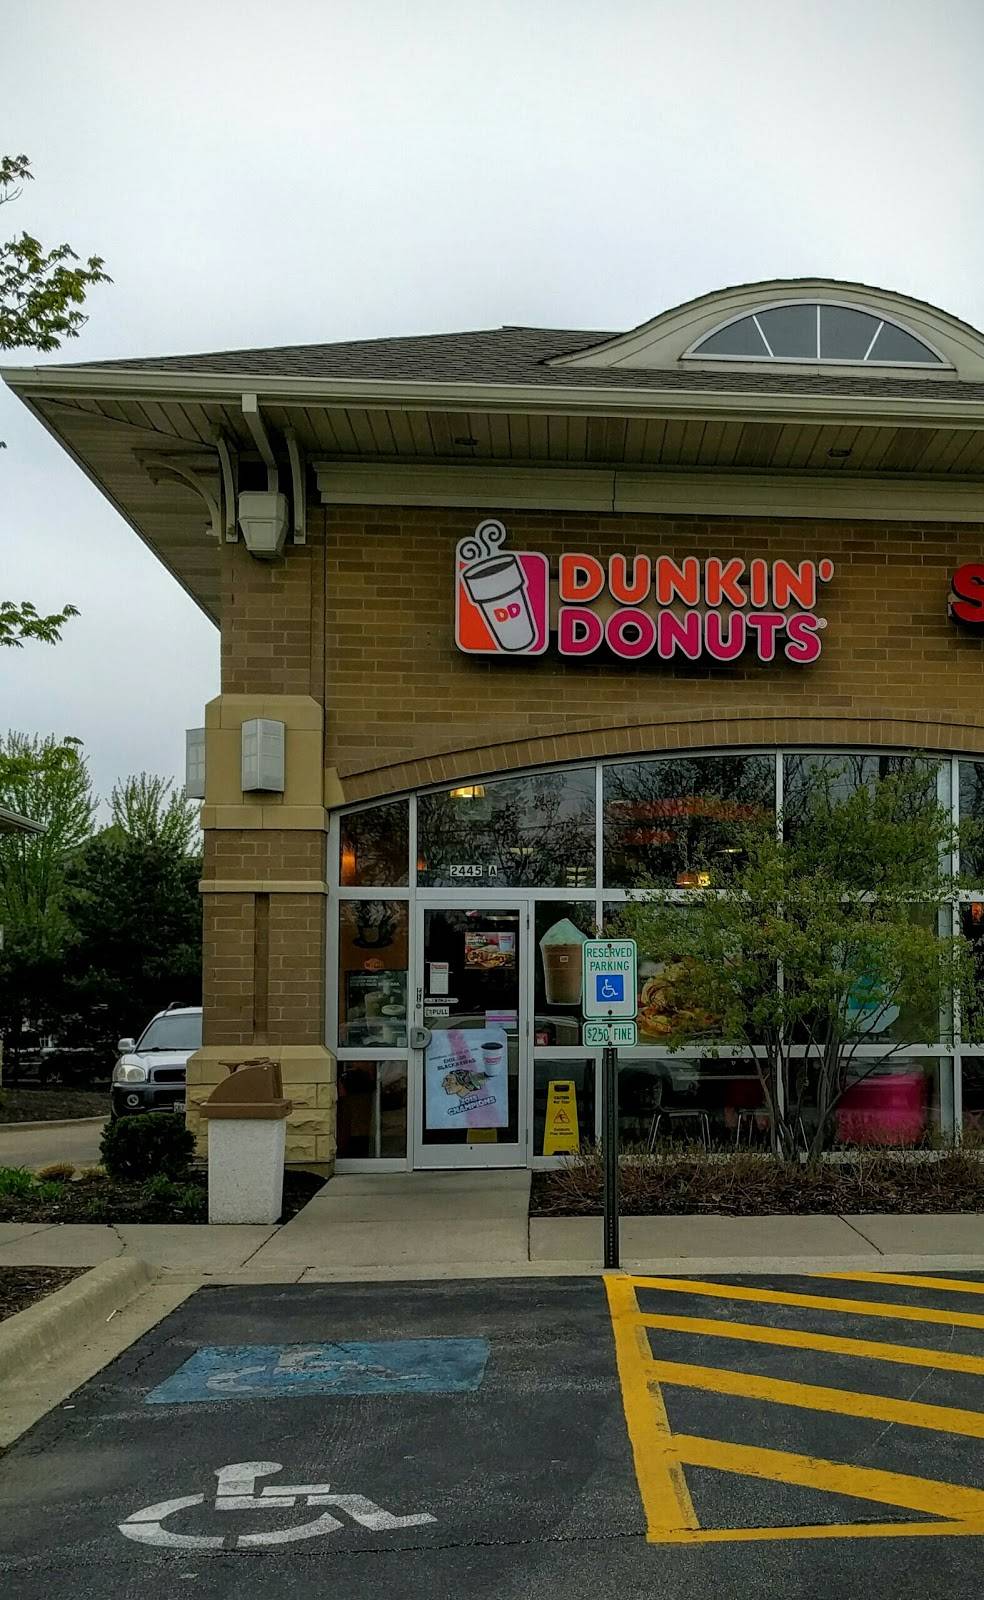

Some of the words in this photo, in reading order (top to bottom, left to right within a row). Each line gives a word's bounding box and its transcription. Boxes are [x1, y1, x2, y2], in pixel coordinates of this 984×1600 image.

[559, 553, 834, 609] DUNKIN'
[493, 603, 521, 622] DD
[451, 866, 482, 876] 2445
[489, 865, 497, 876] A
[586, 947, 633, 958] RESERVED
[590, 961, 630, 972] PARKING
[587, 1027, 610, 1042] $250
[613, 1027, 633, 1041] FINE
[447, 1096, 497, 1115] CHAMPIONS
